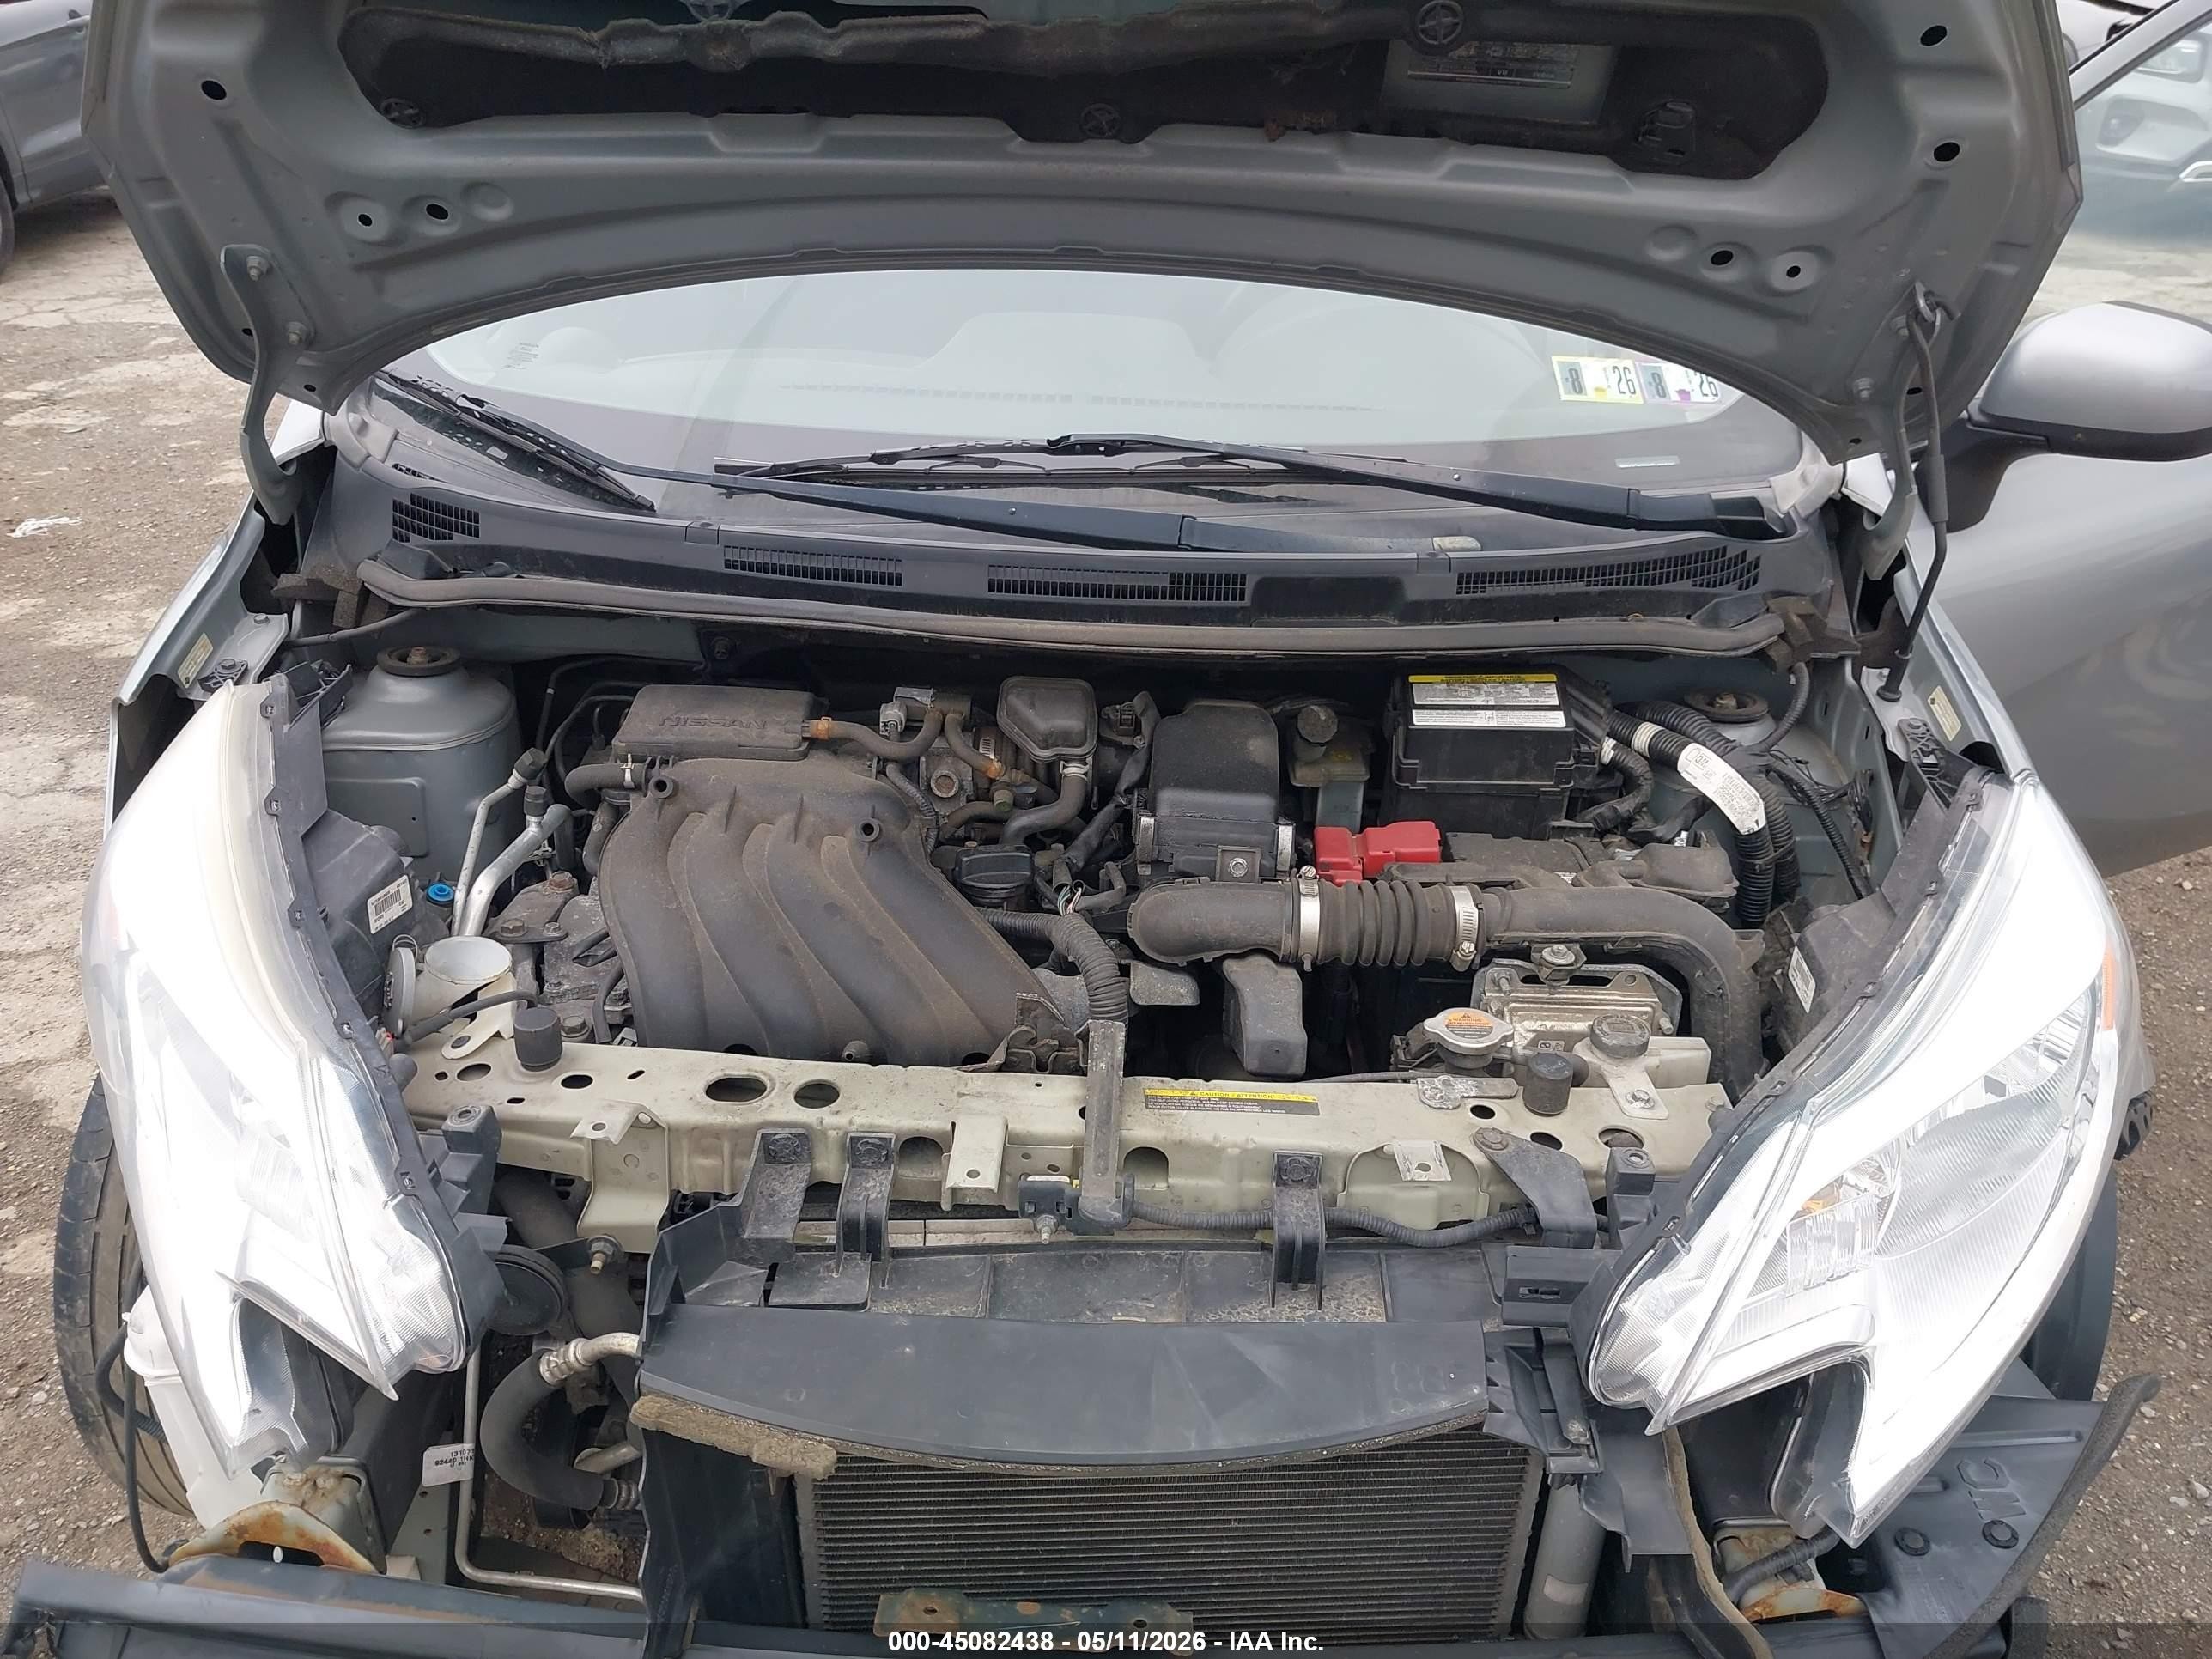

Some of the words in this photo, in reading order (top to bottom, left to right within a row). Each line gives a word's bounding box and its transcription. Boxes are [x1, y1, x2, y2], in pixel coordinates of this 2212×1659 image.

[1568, 368, 1583, 395] 8
[1613, 365, 1637, 396] 26
[1650, 372, 1667, 398] 8
[1694, 370, 1719, 398] 26
[659, 716, 767, 730] NISSAN
